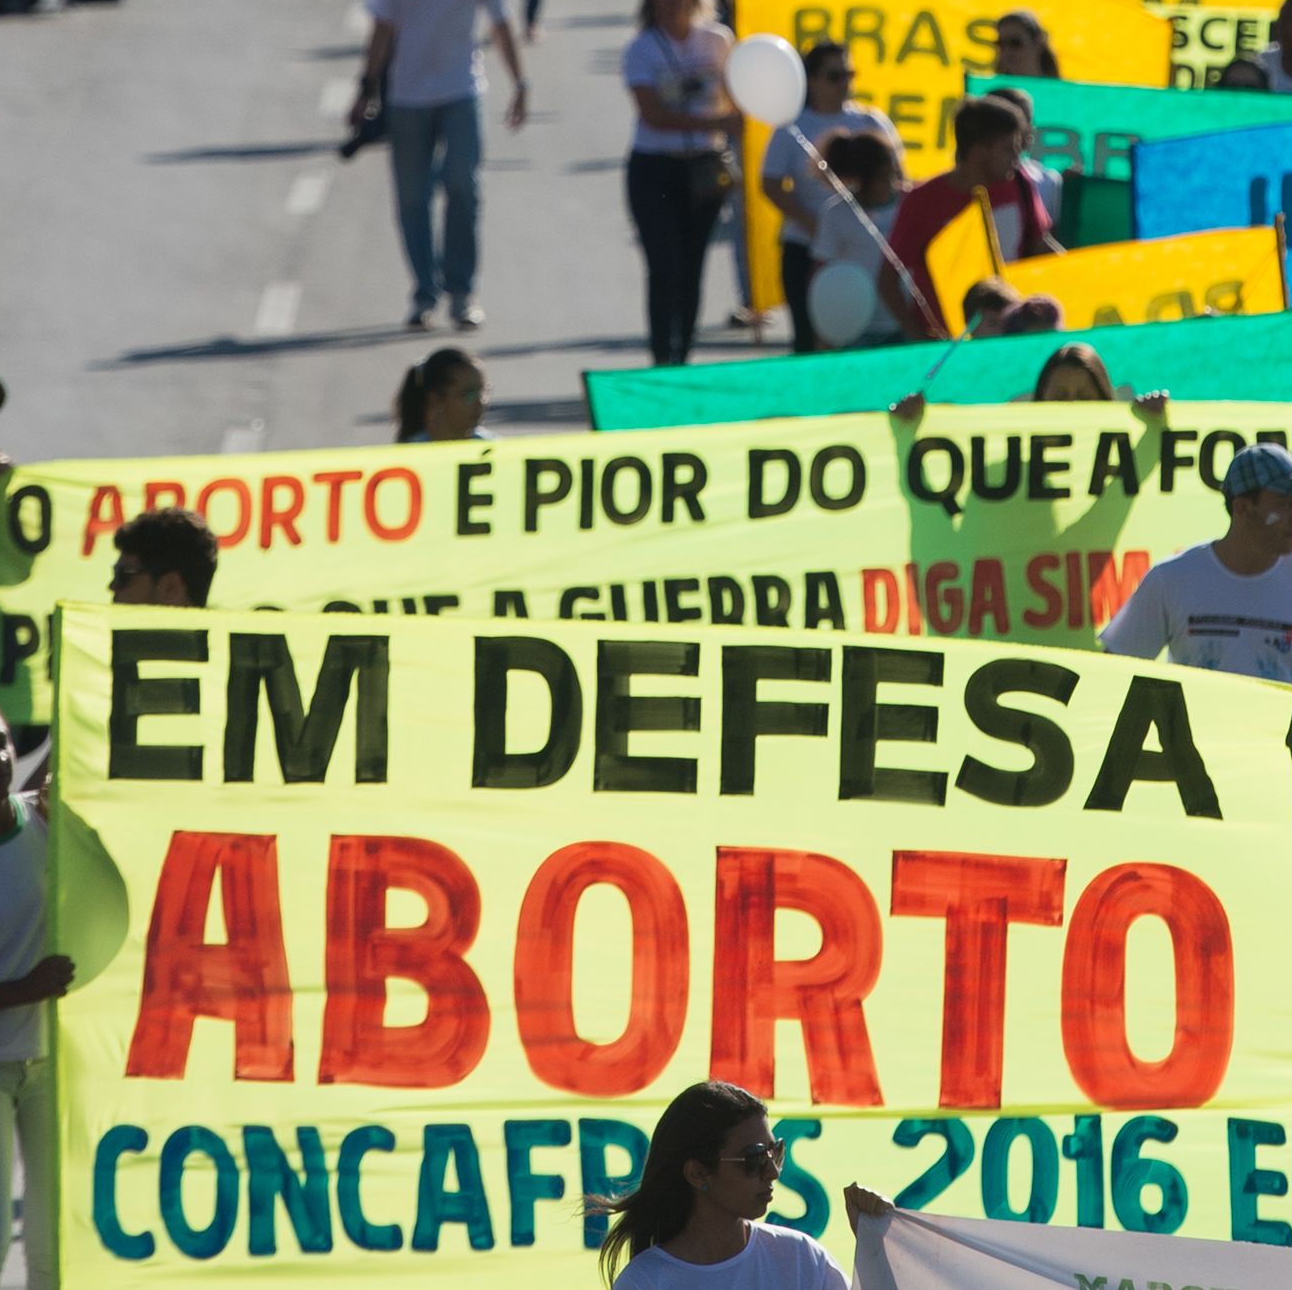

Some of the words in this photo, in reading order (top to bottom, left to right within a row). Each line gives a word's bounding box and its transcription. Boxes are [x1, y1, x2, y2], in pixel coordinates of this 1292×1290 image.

[9, 484, 53, 555] O
[456, 449, 494, 537] É
[523, 451, 709, 533] PIOR
[747, 445, 868, 520] DO
[908, 433, 1072, 518] QUE
[1088, 431, 1139, 497] A
[861, 557, 1012, 637] DIGA
[1021, 550, 1151, 638] SIM
[108, 628, 390, 784] EM
[471, 634, 1224, 821] DEFESA
[124, 829, 1235, 1110] ABORTO
[93, 1116, 832, 1262] CONCAFRS
[892, 1113, 1189, 1235] 2016
